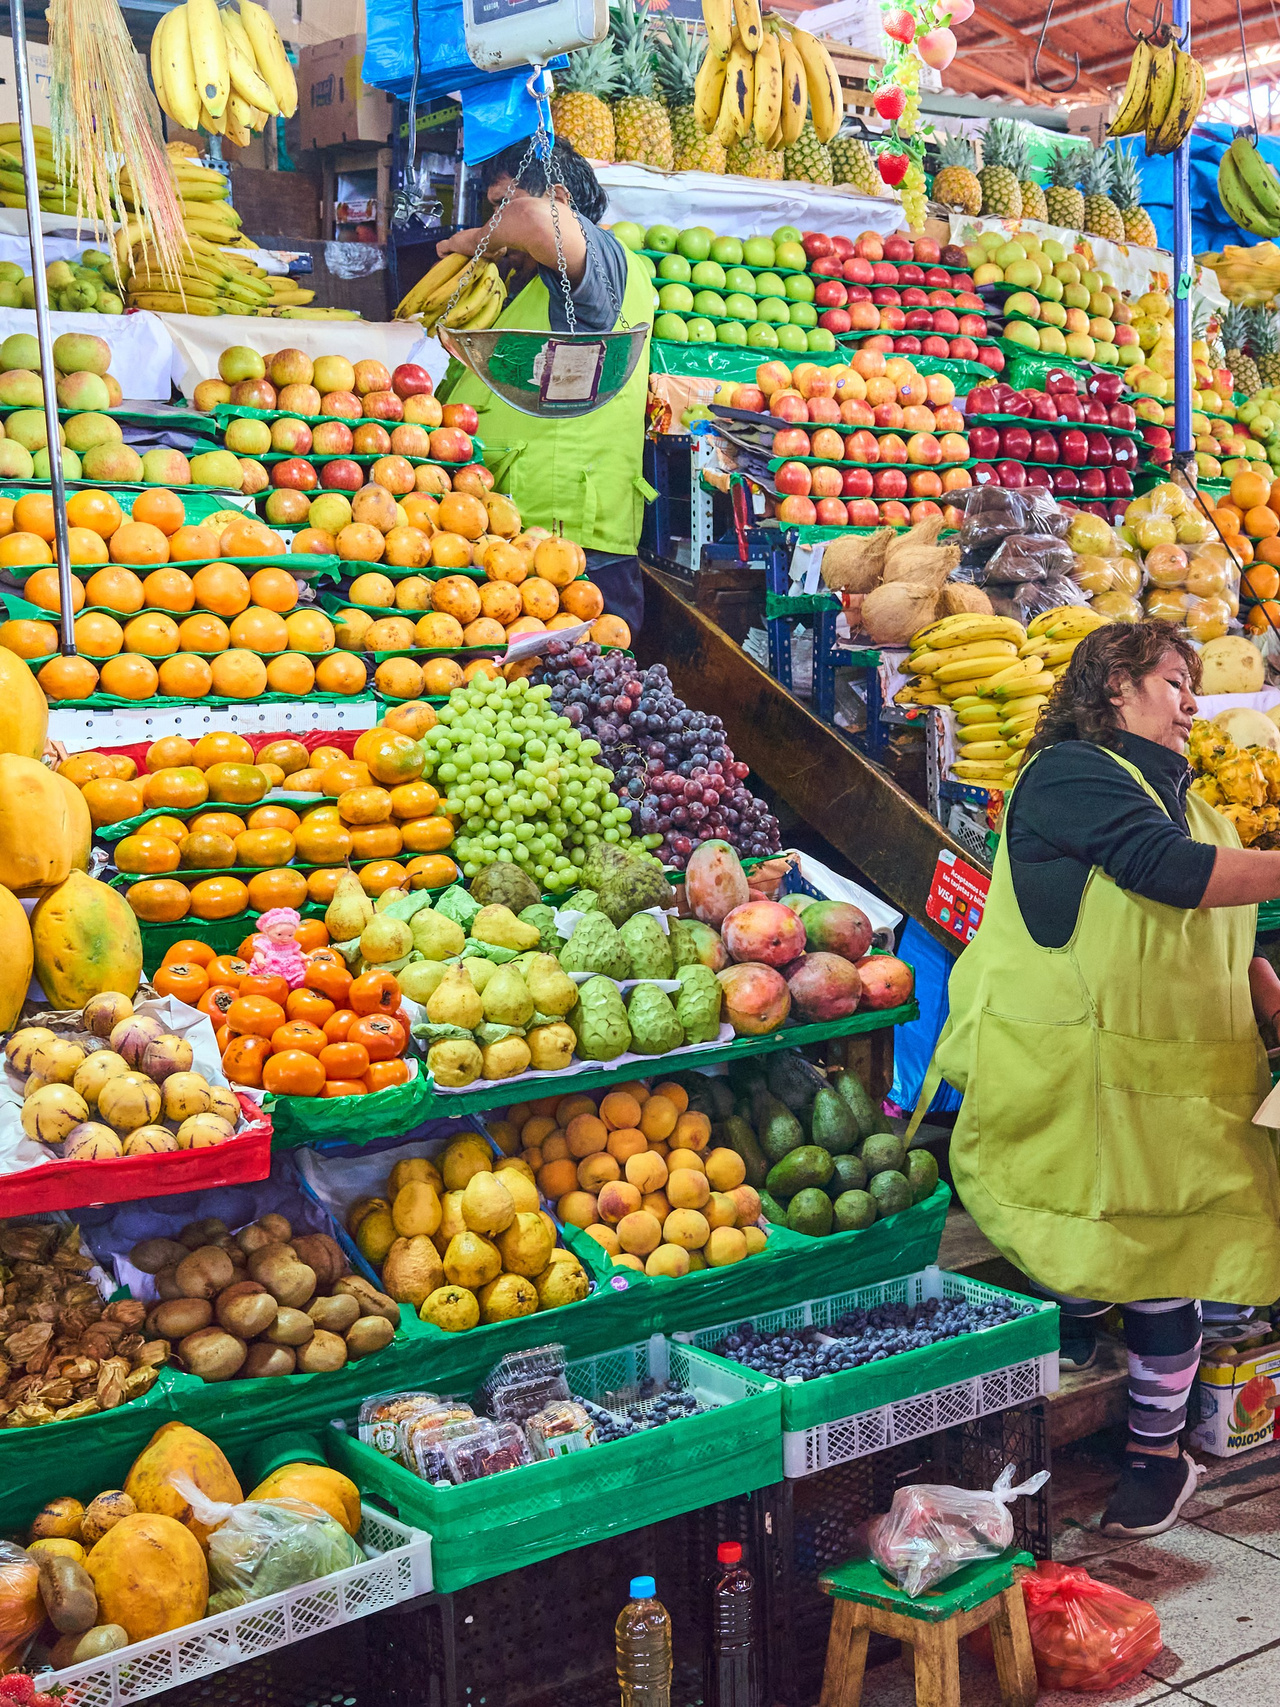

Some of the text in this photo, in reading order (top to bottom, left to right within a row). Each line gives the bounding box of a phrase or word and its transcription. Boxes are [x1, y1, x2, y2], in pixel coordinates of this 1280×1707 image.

[942, 872, 951, 882] las
[950, 878, 970, 898] tarjetas
[951, 869, 979, 894] Aceptamos
[937, 884, 954, 905] VISA
